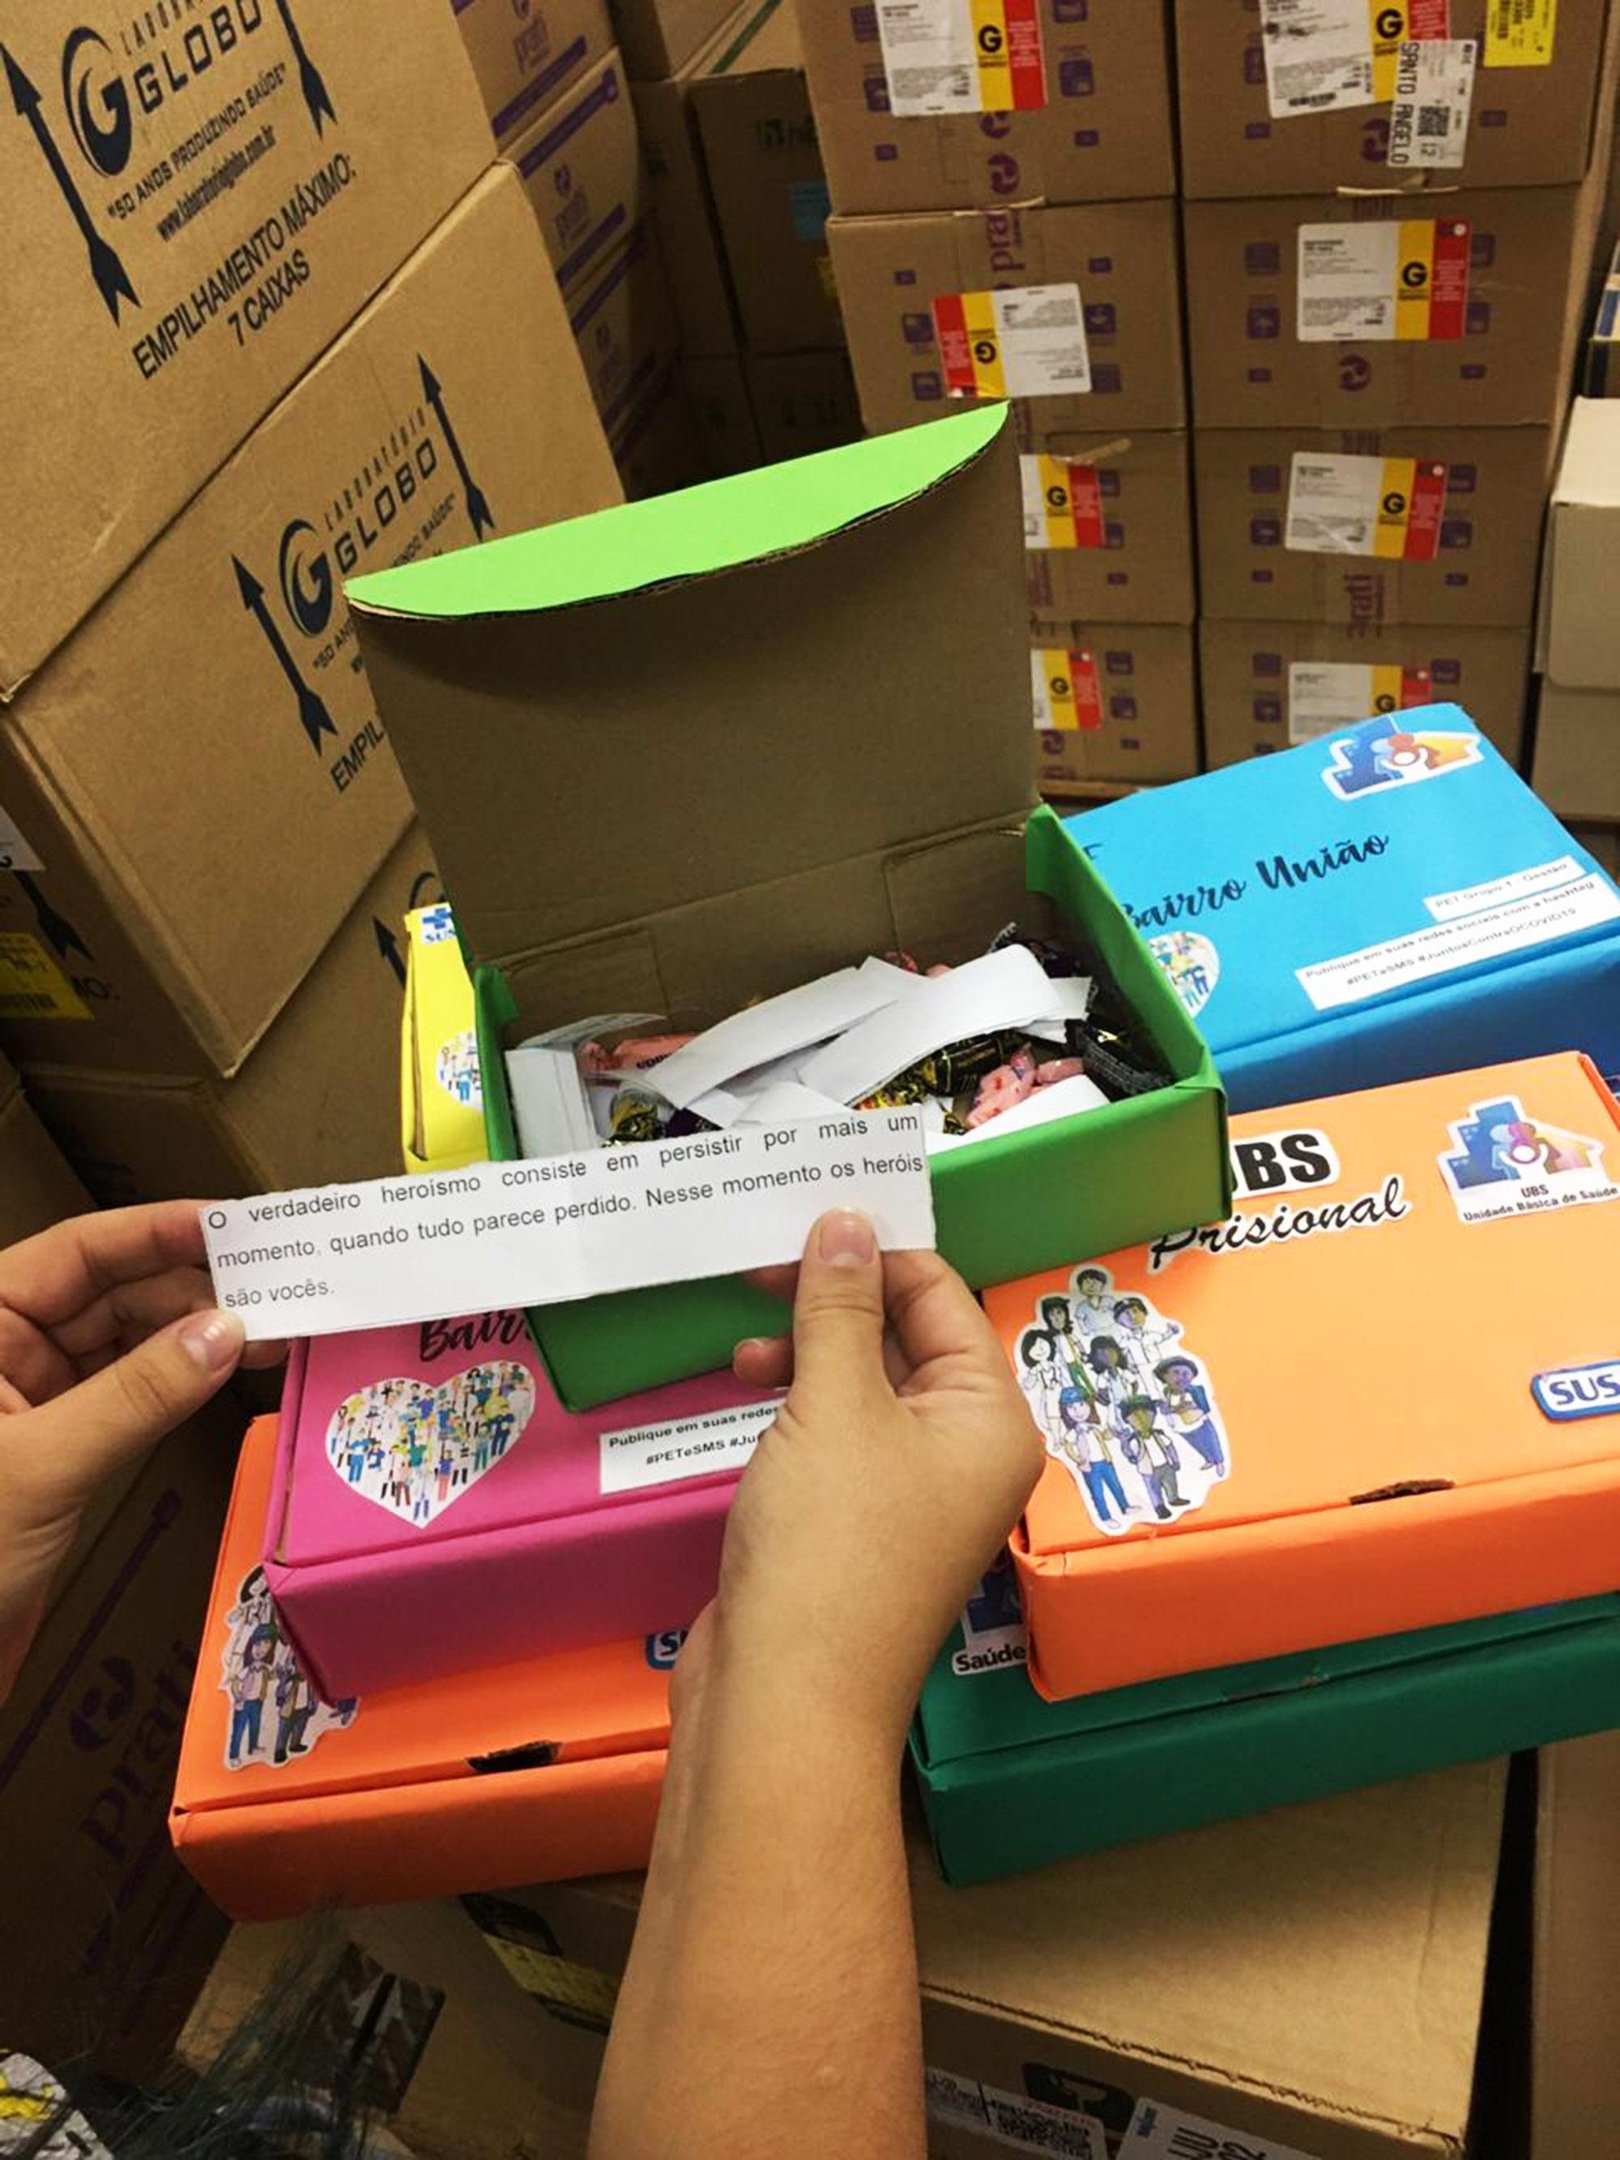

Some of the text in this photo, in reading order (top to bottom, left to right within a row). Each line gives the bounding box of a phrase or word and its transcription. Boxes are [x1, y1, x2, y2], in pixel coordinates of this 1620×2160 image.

[133, 0, 263, 114] GLOBO
[1397, 42, 1420, 95] SANTO
[135, 161, 173, 201] ANOS
[170, 97, 247, 173] PRODUZINDO
[132, 153, 357, 380] EMPILHAMENTO MÁXIMO:
[228, 249, 311, 347] 7 CAIXAS
[334, 437, 437, 575] GLOBO
[329, 720, 386, 793] EMPIL
[1255, 834, 1390, 890] União
[1304, 956, 1361, 980] Publique
[1363, 950, 1383, 960] em
[1384, 939, 1415, 954] suas
[1418, 927, 1453, 944] redes
[1456, 912, 1501, 931] sociais
[1502, 904, 1531, 918] com
[1542, 881, 1596, 907] hashtag
[208, 1115, 918, 1230] O verdadeiro heroísmo consiste em persistir por mais um
[1230, 1133, 1332, 1192] BS
[330, 1227, 409, 1256] quando
[417, 1218, 464, 1240] tudo
[473, 1208, 545, 1235] parece
[554, 1194, 637, 1222] perdido.
[645, 1184, 714, 1208] Nesse
[722, 1165, 822, 1196] momento
[830, 1160, 855, 1178] os
[863, 1152, 924, 1176] heróis
[1463, 1186, 1619, 1222] Unidade Básica de Saúde
[1520, 1184, 1549, 1199] UBS
[225, 1277, 335, 1308] são vocês.
[419, 1308, 533, 1362] Bair
[1549, 1373, 1620, 1405] SUS
[608, 1427, 673, 1448] Publique
[675, 1423, 699, 1433] em
[702, 1414, 737, 1429] suas
[645, 1438, 726, 1465] #PETeSMS
[955, 1643, 1027, 1672] Saúde
